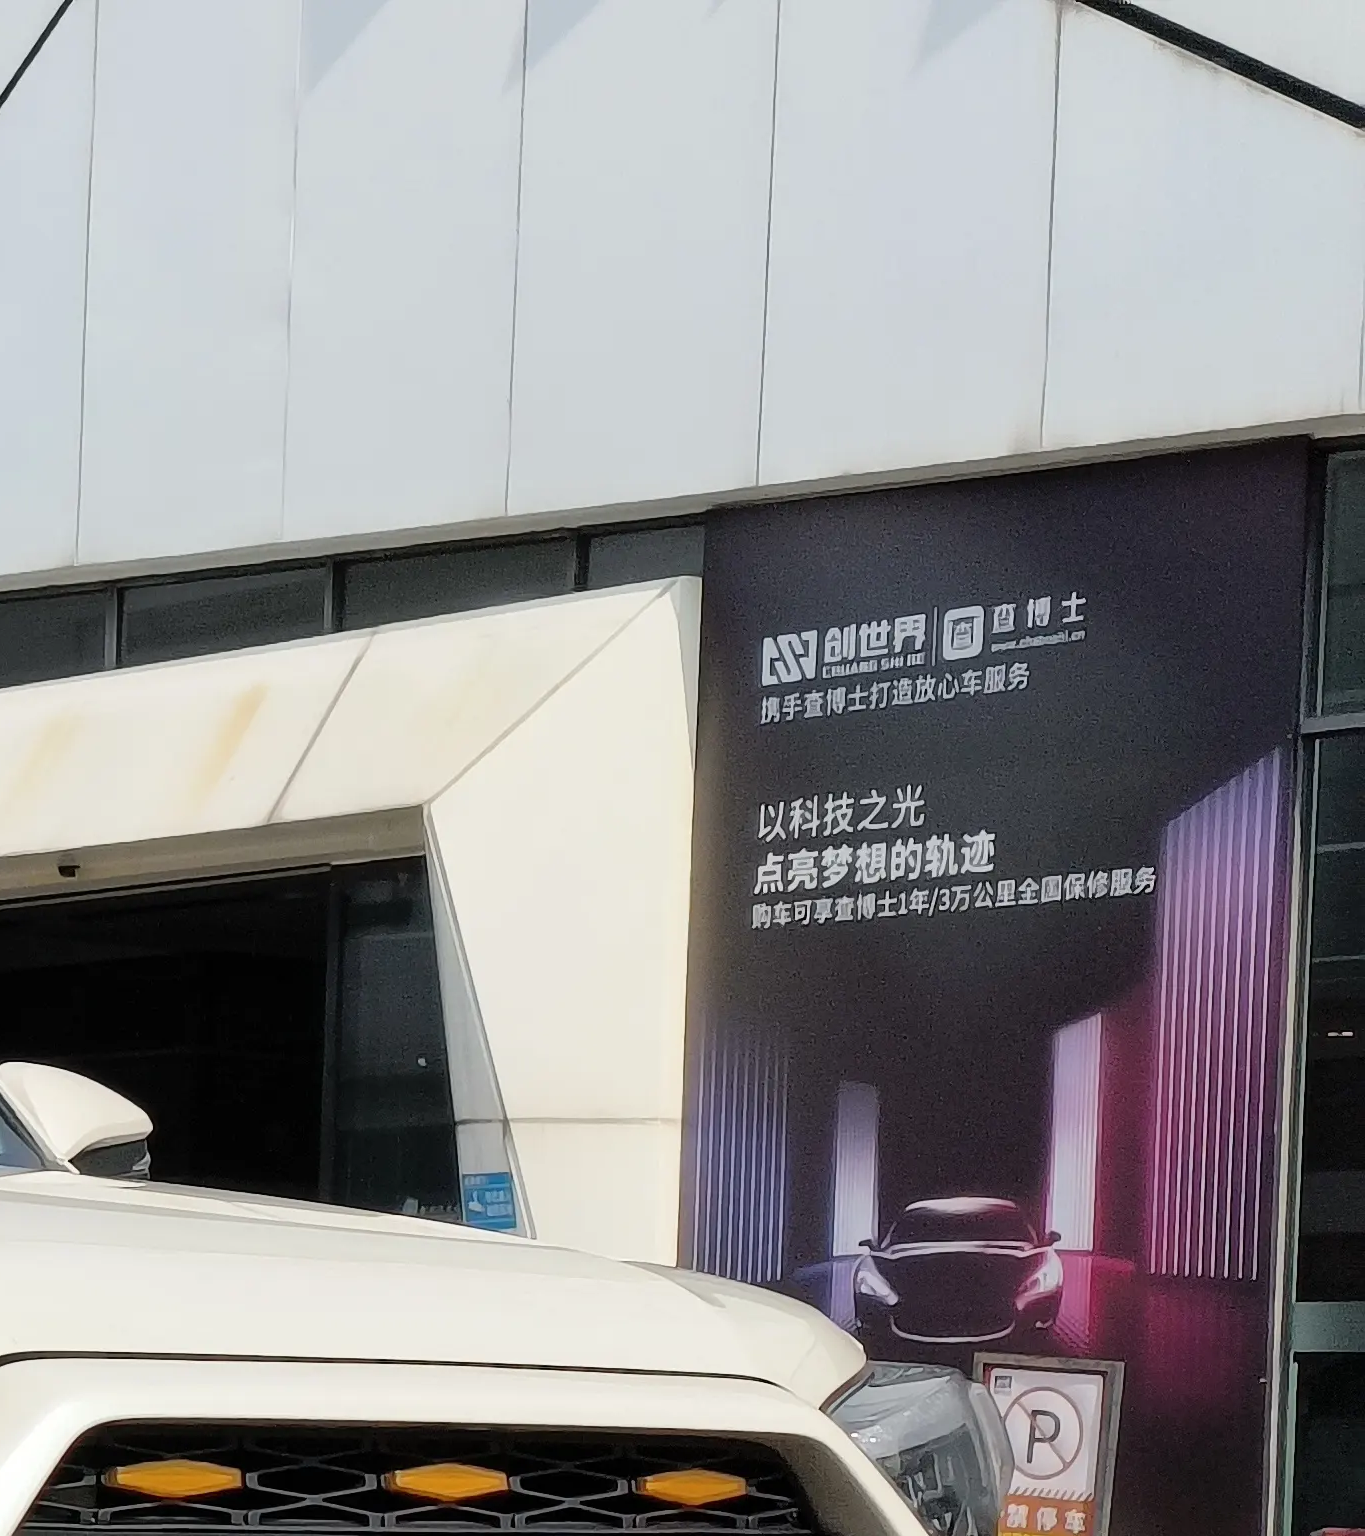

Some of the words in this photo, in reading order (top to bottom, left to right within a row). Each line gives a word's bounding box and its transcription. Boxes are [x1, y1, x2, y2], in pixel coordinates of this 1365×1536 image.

[823, 613, 927, 664] 创世界
[760, 662, 1030, 726] 携手查博士打造放心车服务
[756, 784, 926, 843] 以科技之光
[752, 829, 997, 895] 点亮梦想的轨迹
[750, 865, 1158, 930] 购车可享查博士1年/3万公里全国保修服务
[1026, 1409, 1061, 1464] P
